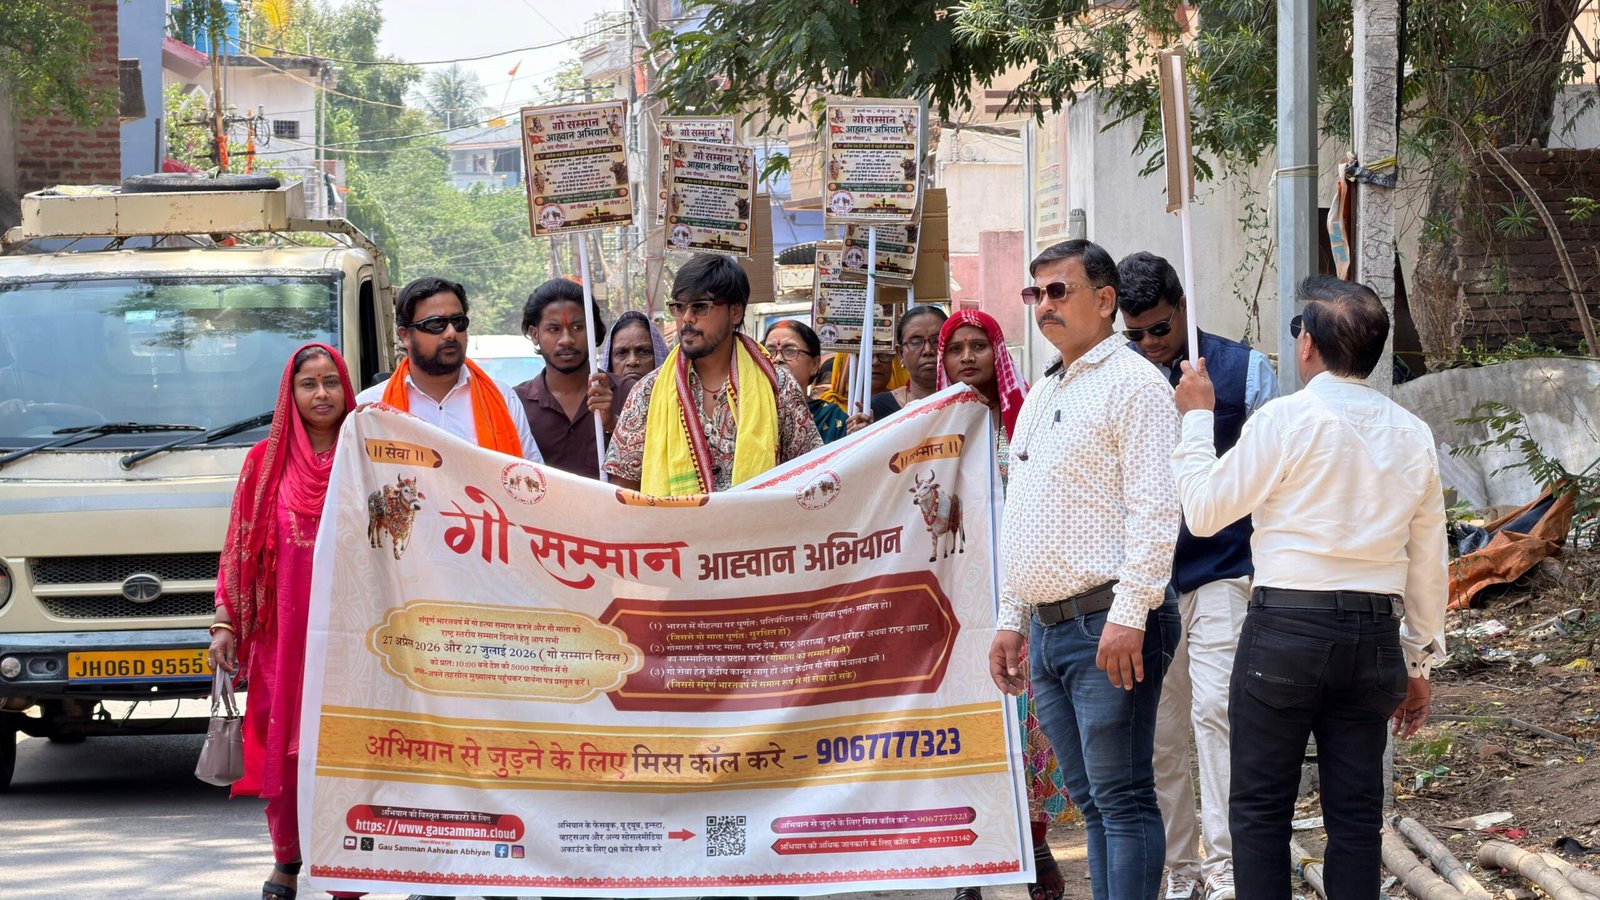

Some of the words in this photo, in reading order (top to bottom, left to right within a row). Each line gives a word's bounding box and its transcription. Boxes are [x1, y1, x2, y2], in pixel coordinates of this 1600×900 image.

[385, 443, 411, 460] सेवा
[439, 485, 517, 565] गो
[520, 525, 689, 590] सम्मान
[804, 526, 903, 573] अभियान
[649, 621, 662, 631] (1)
[666, 622, 687, 630] भारत
[688, 621, 696, 629] में
[856, 602, 880, 612] समाप्त
[534, 622, 546, 632] और
[650, 643, 664, 653] (2)
[694, 643, 704, 651] को
[906, 624, 930, 632] आधार
[382, 636, 393, 645] 27
[416, 641, 441, 652] 2026
[444, 640, 463, 653] और
[465, 645, 478, 654] 27
[480, 644, 507, 659] जुलाई
[509, 648, 537, 659] 2026
[547, 647, 558, 660] गो
[560, 651, 593, 661] सम्मान
[595, 649, 620, 662] दिवस
[678, 654, 713, 662] सम्मानित
[807, 648, 830, 658] सम्मान
[75, 659, 145, 677] JH06D
[151, 656, 203, 675] 9555
[511, 664, 530, 672] 5000
[650, 668, 664, 678] (3)
[676, 666, 692, 675] सेवा
[730, 668, 752, 678] कानून
[754, 668, 769, 678] लागू
[770, 666, 778, 675] हो
[780, 664, 793, 674] और
[824, 659, 839, 668] सेवा
[760, 680, 780, 688] समान
[365, 728, 454, 764] अभियान
[459, 737, 482, 767] से
[487, 740, 544, 778] जुड़ने
[550, 741, 574, 771] के
[578, 742, 627, 779] लिए
[631, 743, 684, 775] मिस
[689, 746, 742, 774] कॉल
[746, 742, 786, 771] करे
[816, 727, 961, 765] 9067777323
[381, 807, 408, 817] अभियान
[441, 812, 470, 821] जानकारी
[780, 820, 809, 829] अभियान
[846, 817, 861, 828] लिए
[862, 816, 878, 826] मिस
[917, 813, 968, 823] 9067777323
[356, 818, 516, 840] https://www.gausamman.cloud
[557, 820, 584, 829] अभियान
[584, 820, 592, 829] के
[592, 832, 604, 840] और
[780, 842, 807, 850] अभियान
[840, 838, 869, 848] जानकारी
[928, 834, 971, 844] 9571712140
[394, 844, 426, 853] Samman
[427, 846, 459, 855] Aahvaan
[460, 848, 491, 857] Abhiyan
[586, 844, 592, 853] के
[594, 844, 607, 854] लिए
[608, 846, 618, 854] QR
[620, 844, 633, 853] कोड
